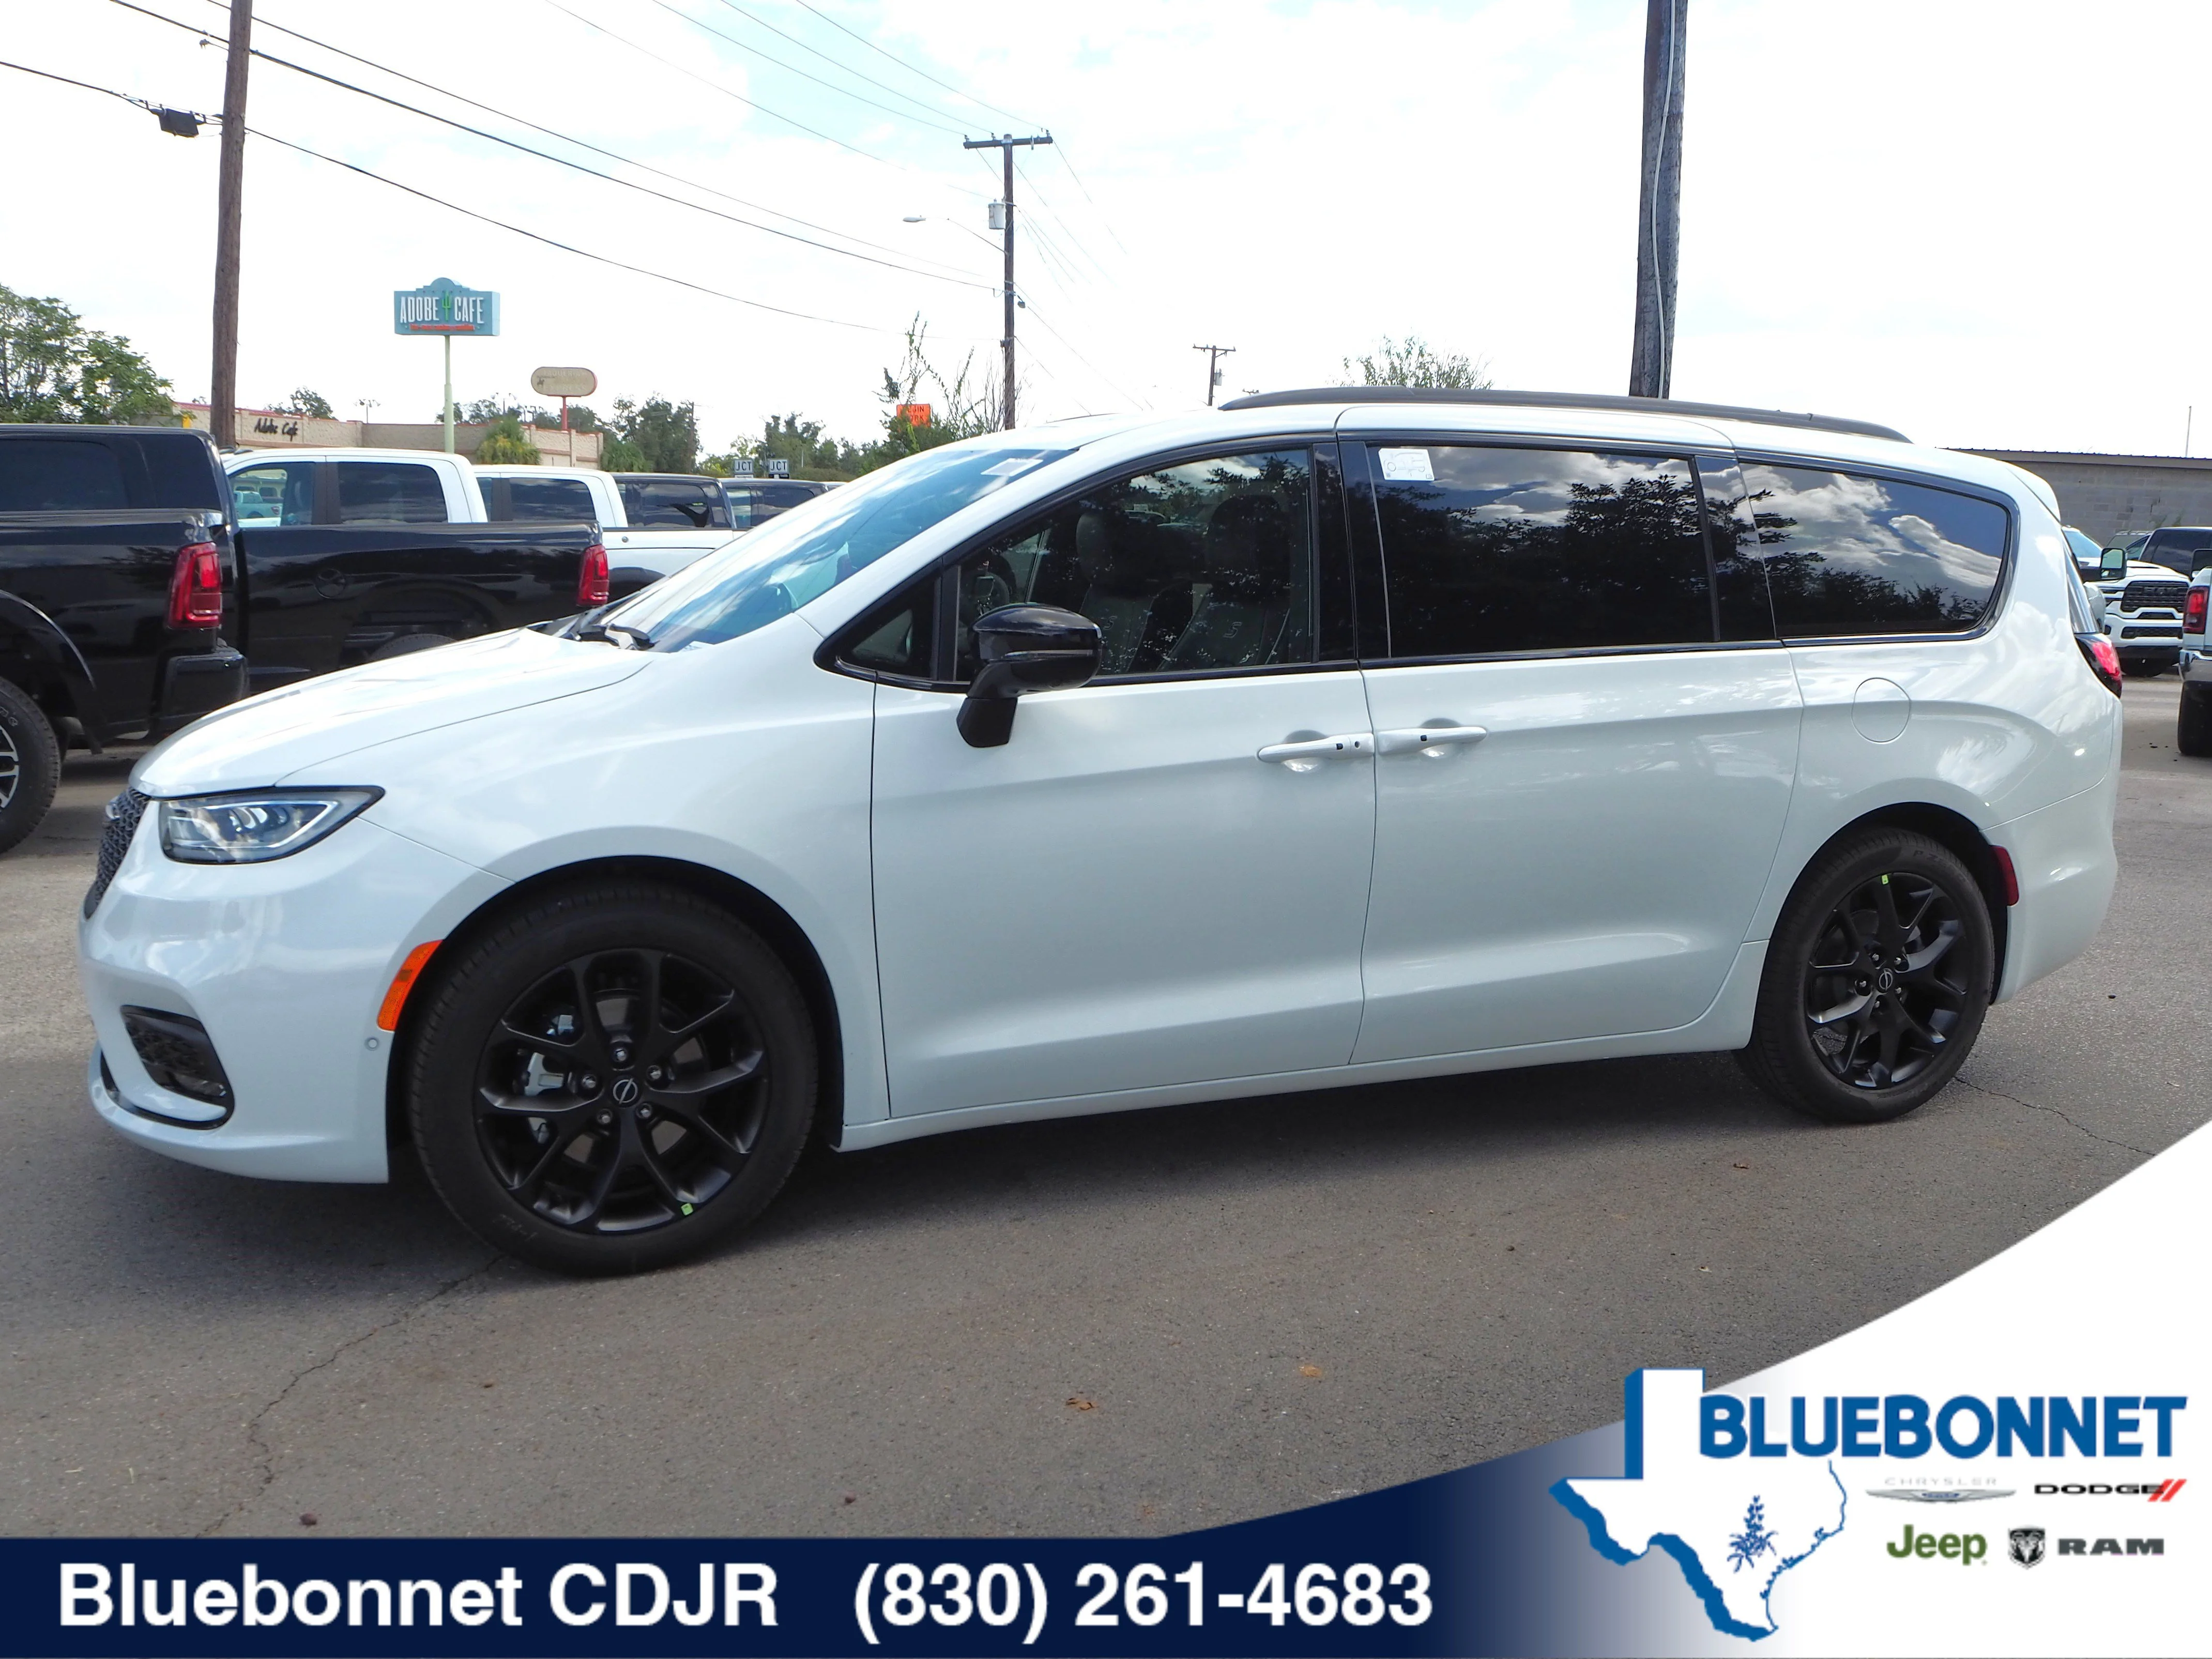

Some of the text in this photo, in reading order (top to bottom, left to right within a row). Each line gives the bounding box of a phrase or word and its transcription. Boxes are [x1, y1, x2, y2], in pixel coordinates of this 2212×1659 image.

[400, 296, 484, 324] ADOBE CAFE
[736, 461, 752, 471] JCT
[770, 461, 787, 471] JCT
[1223, 621, 1242, 638] S
